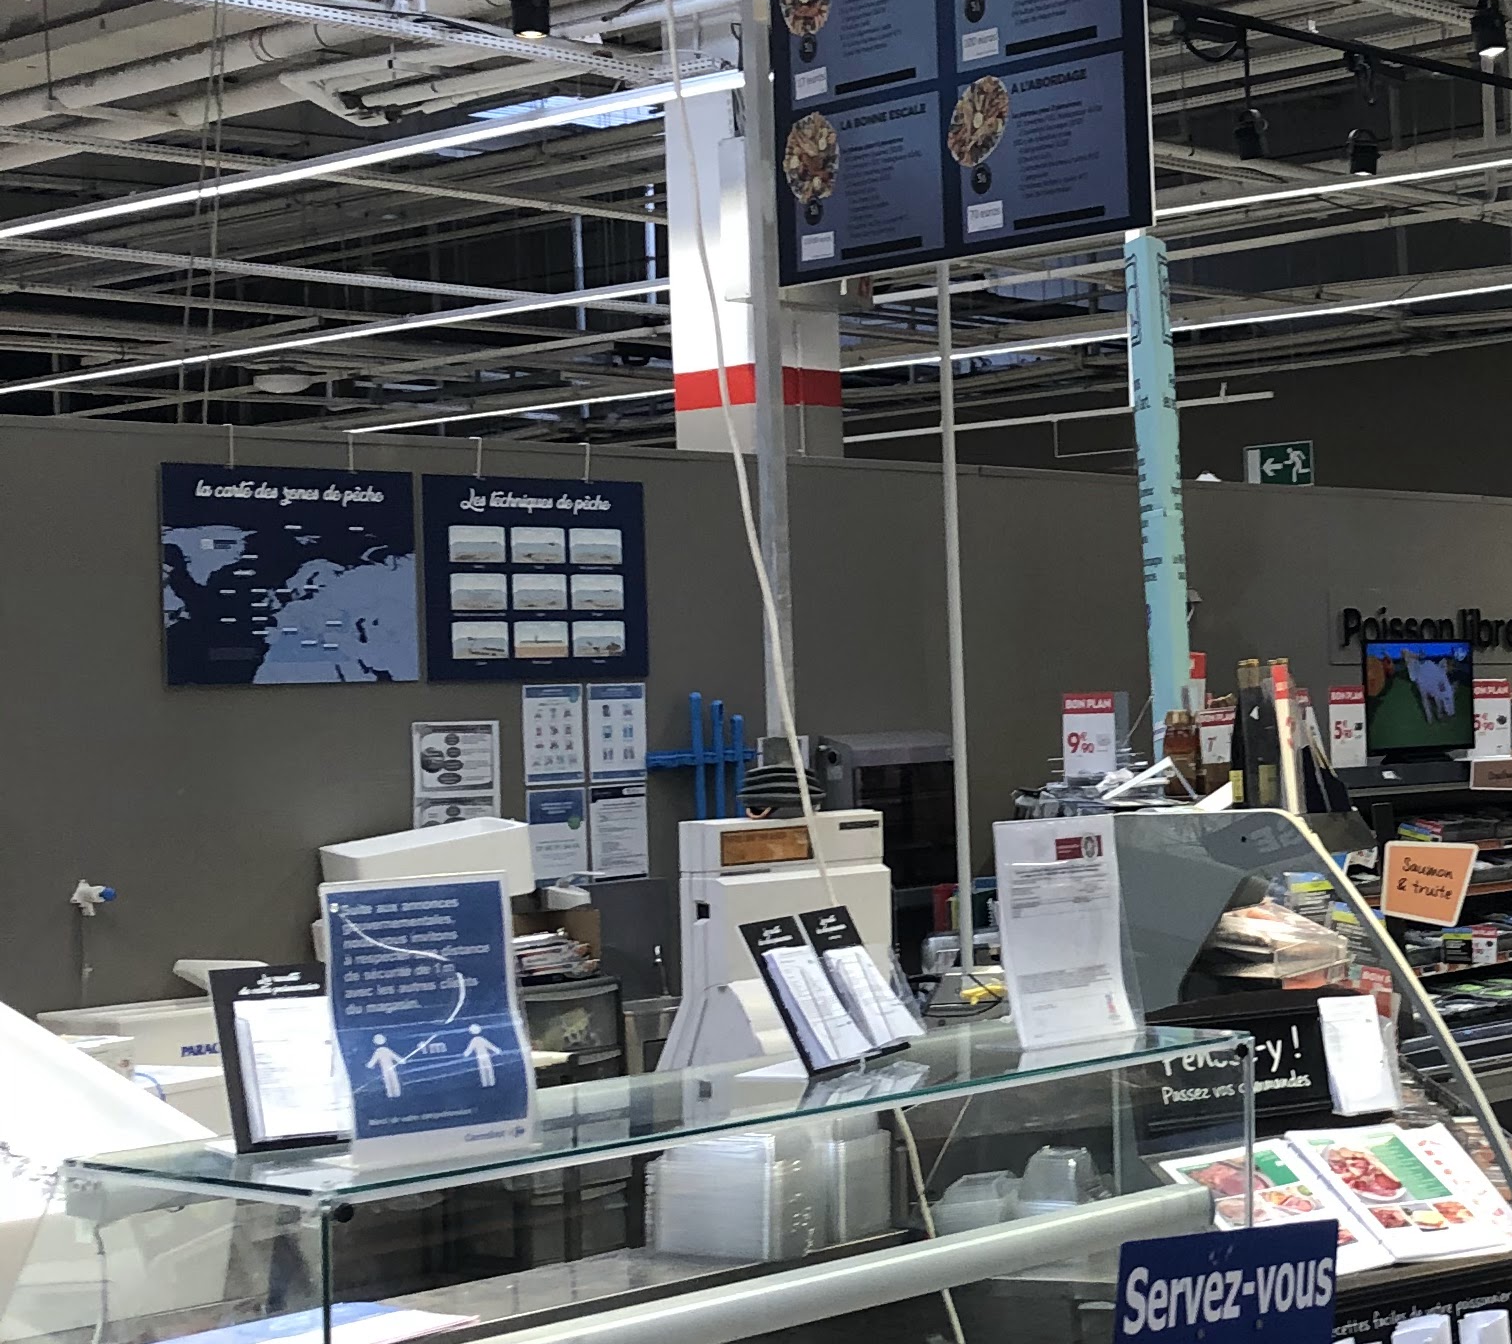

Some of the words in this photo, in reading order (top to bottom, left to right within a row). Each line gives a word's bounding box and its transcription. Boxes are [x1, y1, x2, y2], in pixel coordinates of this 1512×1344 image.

[214, 480, 254, 499] carte
[254, 482, 278, 499] des
[323, 484, 341, 502] de
[460, 488, 486, 512] Les
[489, 491, 553, 514] techniques
[556, 494, 573, 510] de
[1341, 607, 1454, 647] Poisson
[1402, 857, 1453, 880] Saumon
[1397, 877, 1407, 891] &
[1412, 880, 1453, 900] truite
[1161, 1086, 1211, 1105] Passez
[1213, 1083, 1234, 1099] vos
[1238, 1069, 1312, 1096] cmmandes
[1122, 1256, 1336, 1336] Servez-vous
